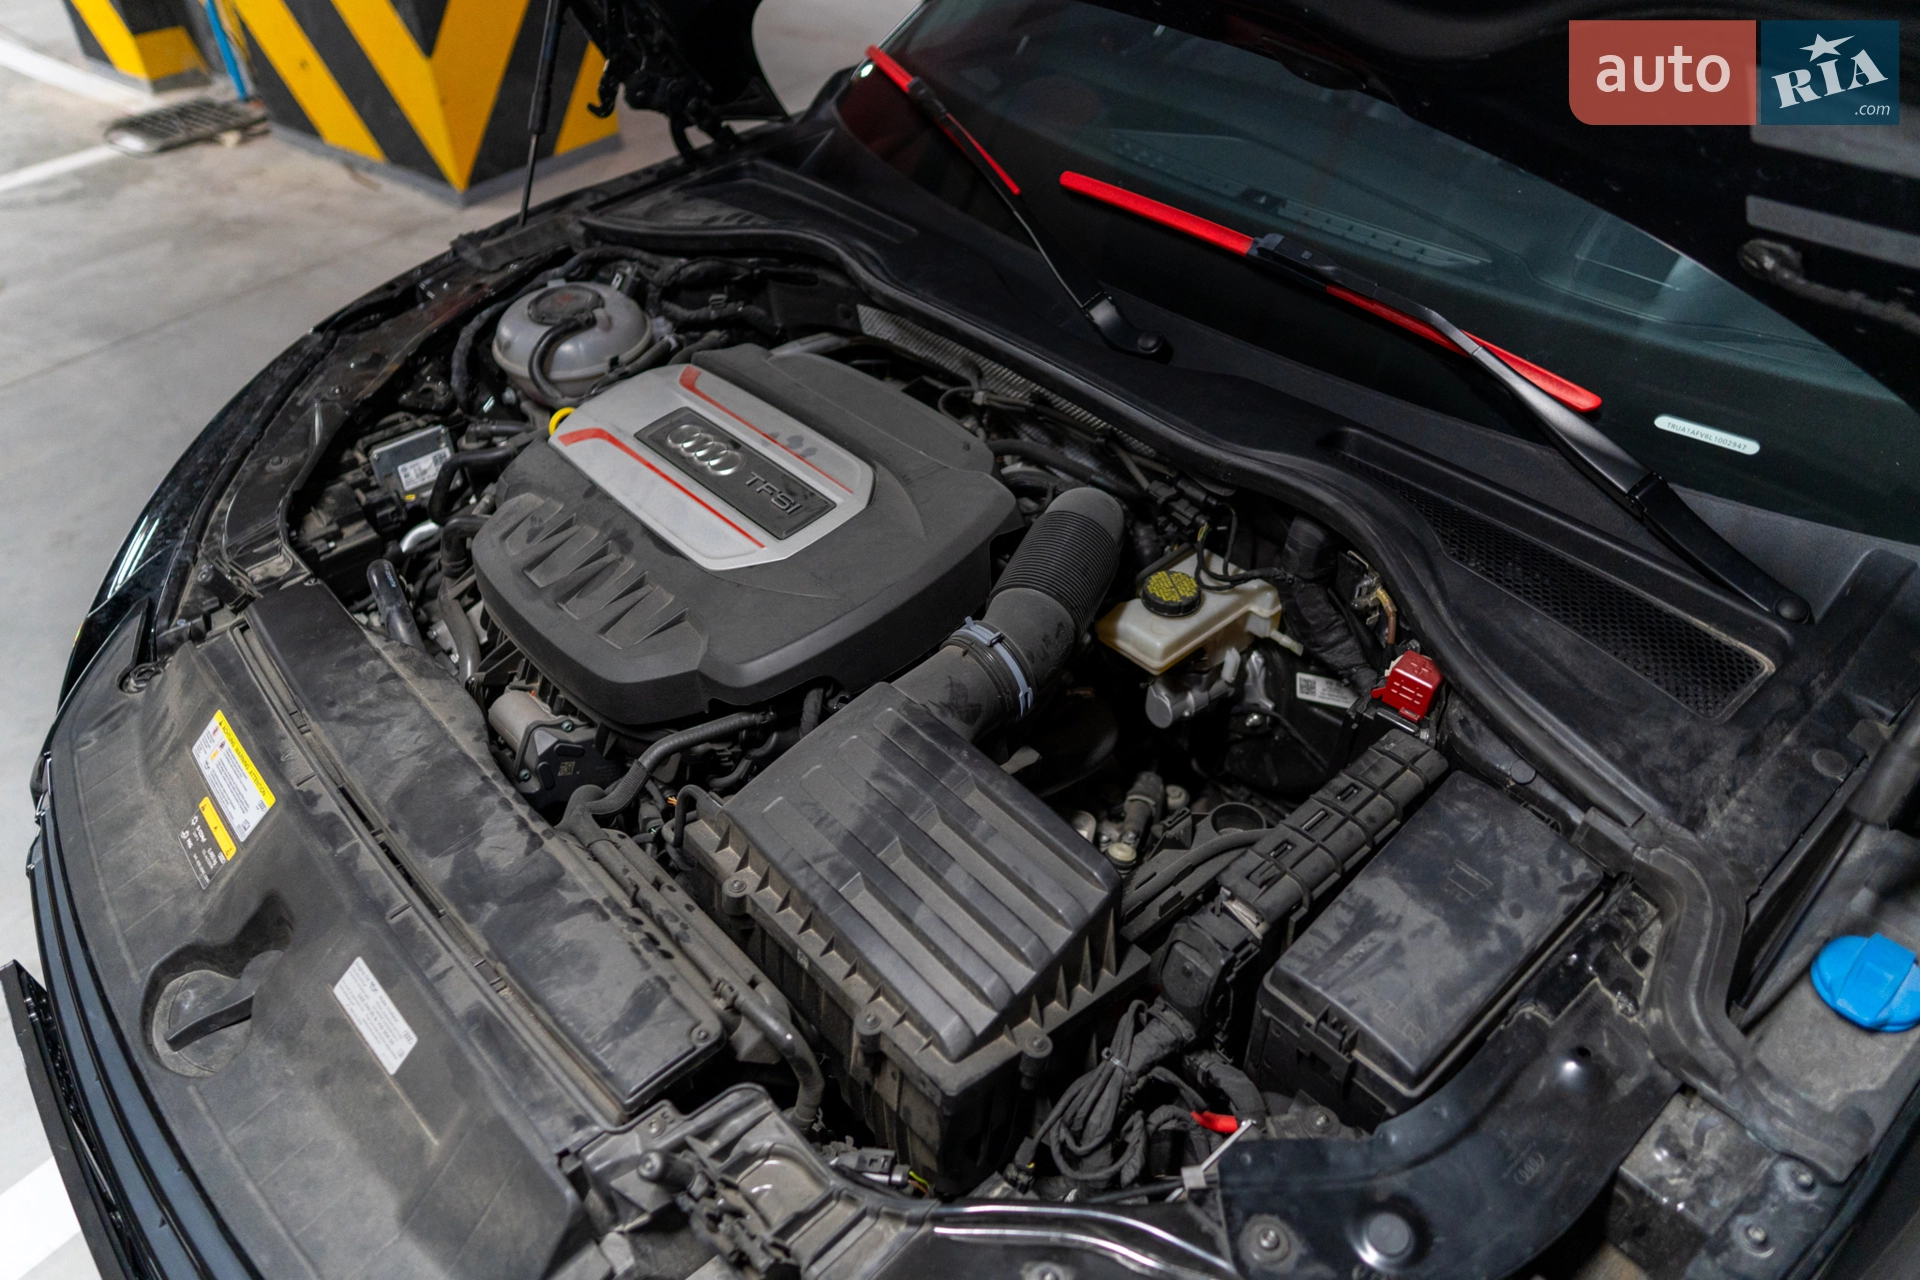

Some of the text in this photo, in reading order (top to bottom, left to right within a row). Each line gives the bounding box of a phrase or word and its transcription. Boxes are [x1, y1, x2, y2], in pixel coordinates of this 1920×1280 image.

[1666, 422, 1747, 451] TRUA1AFV6L1002947
[745, 471, 802, 514] TFSI
[234, 747, 250, 771] WARNING
[249, 770, 267, 797] ATTENTION
